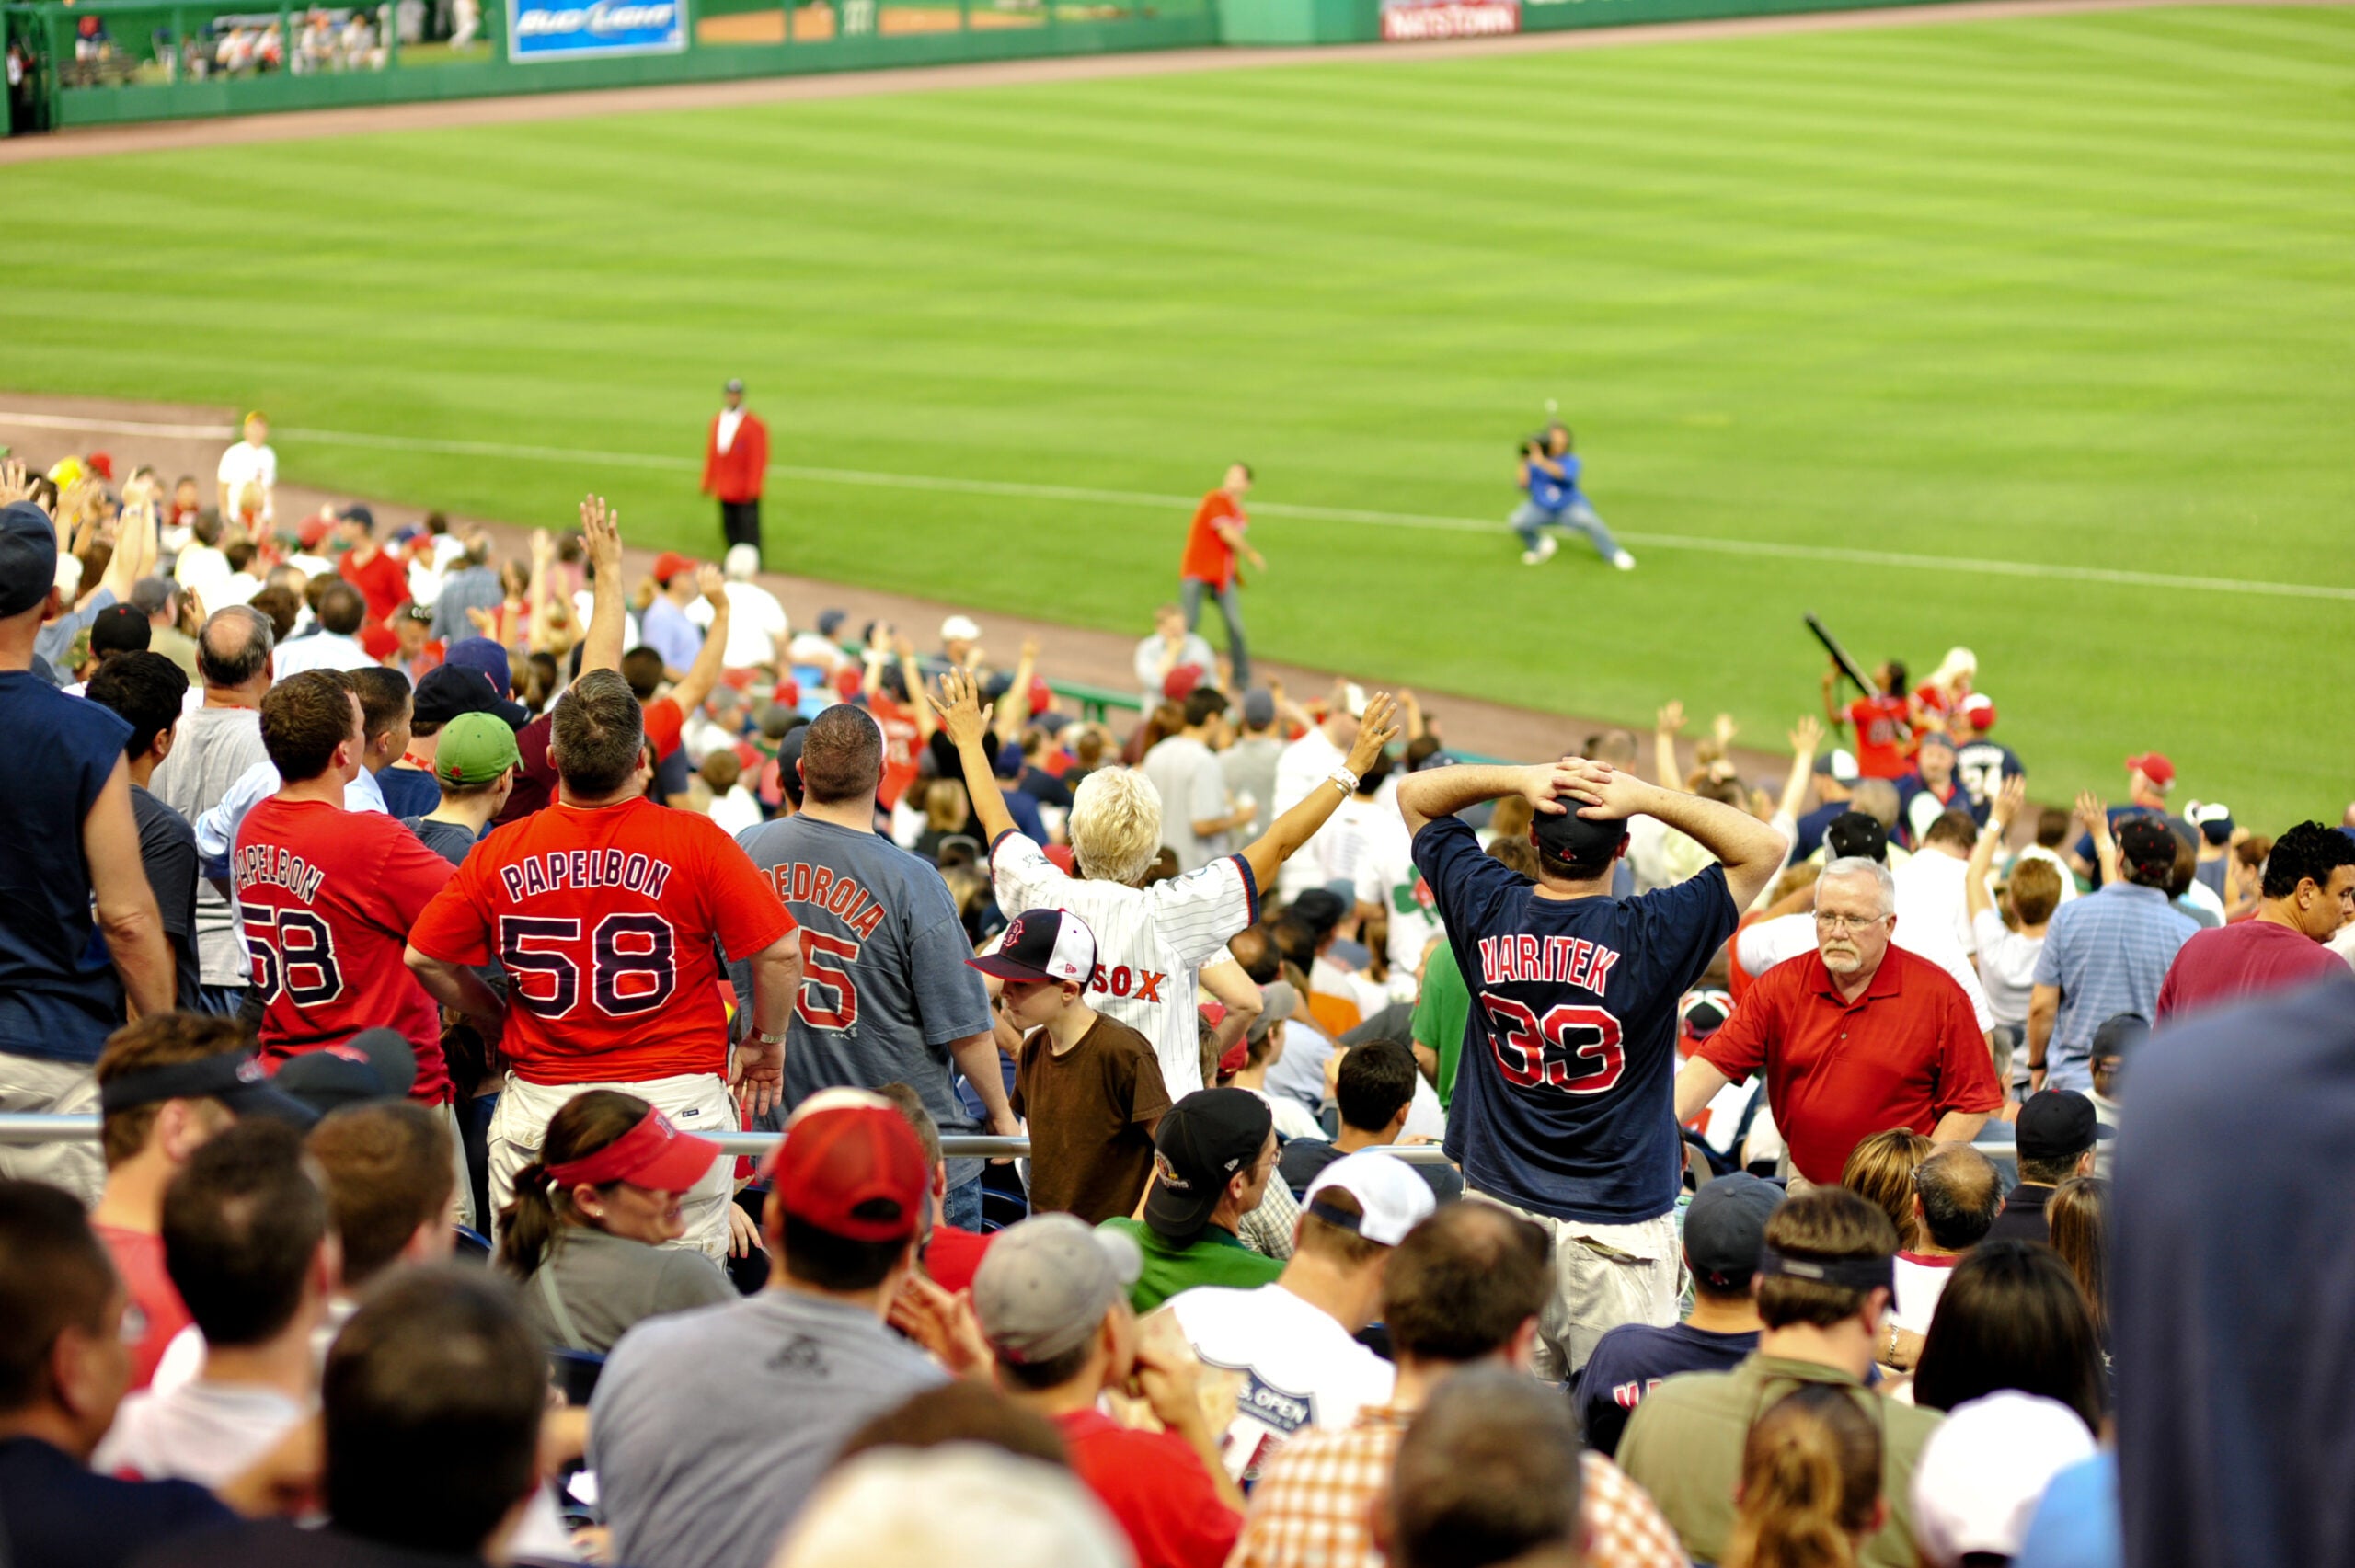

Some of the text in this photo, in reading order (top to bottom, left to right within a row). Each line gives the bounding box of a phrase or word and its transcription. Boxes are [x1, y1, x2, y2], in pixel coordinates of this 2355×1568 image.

[500, 848, 672, 903] PAPELBON
[239, 902, 344, 1008] 58
[499, 912, 676, 1019] 58
[1092, 964, 1167, 1003] SOX
[1478, 933, 1620, 997] VARITEK
[1479, 990, 1626, 1094] 33
[1254, 1387, 1309, 1425] OPEN
